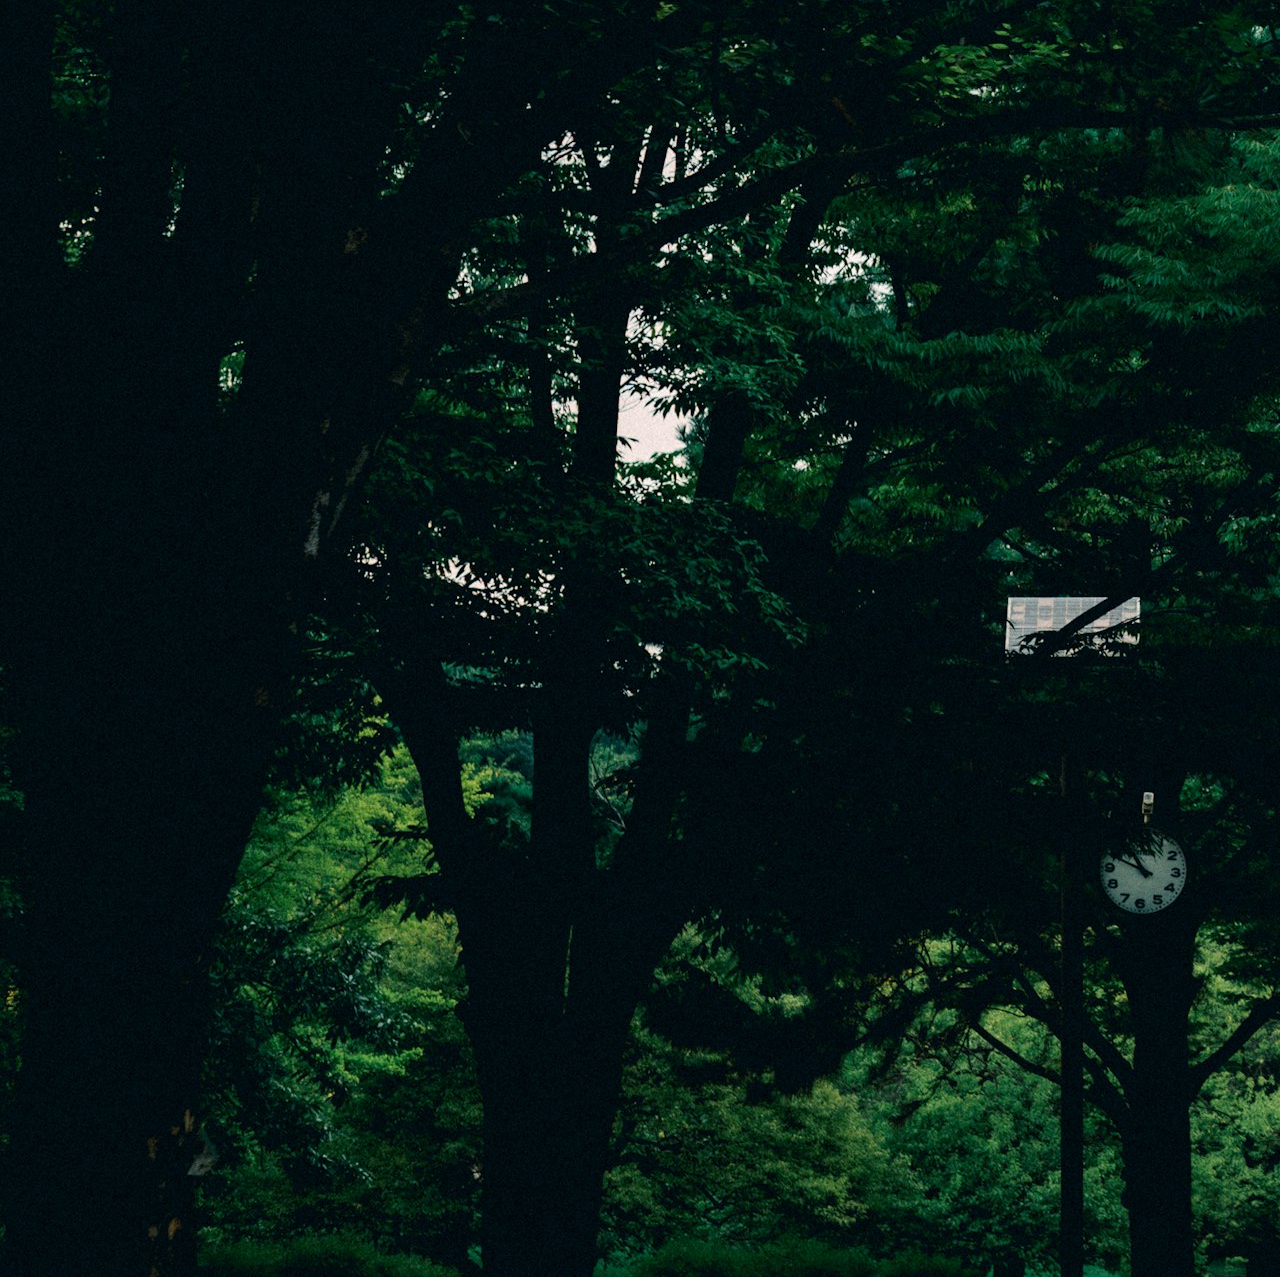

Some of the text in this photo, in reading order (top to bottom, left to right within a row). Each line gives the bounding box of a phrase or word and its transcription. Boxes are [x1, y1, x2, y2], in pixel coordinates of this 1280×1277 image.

[1167, 851, 1177, 860] 2
[1104, 862, 1115, 872] 9
[1170, 868, 1180, 878] 3
[1108, 879, 1118, 888] 8
[1164, 884, 1175, 892] 4
[1120, 893, 1130, 902] 7
[1153, 894, 1163, 904] 5
[1134, 898, 1145, 908] 6
